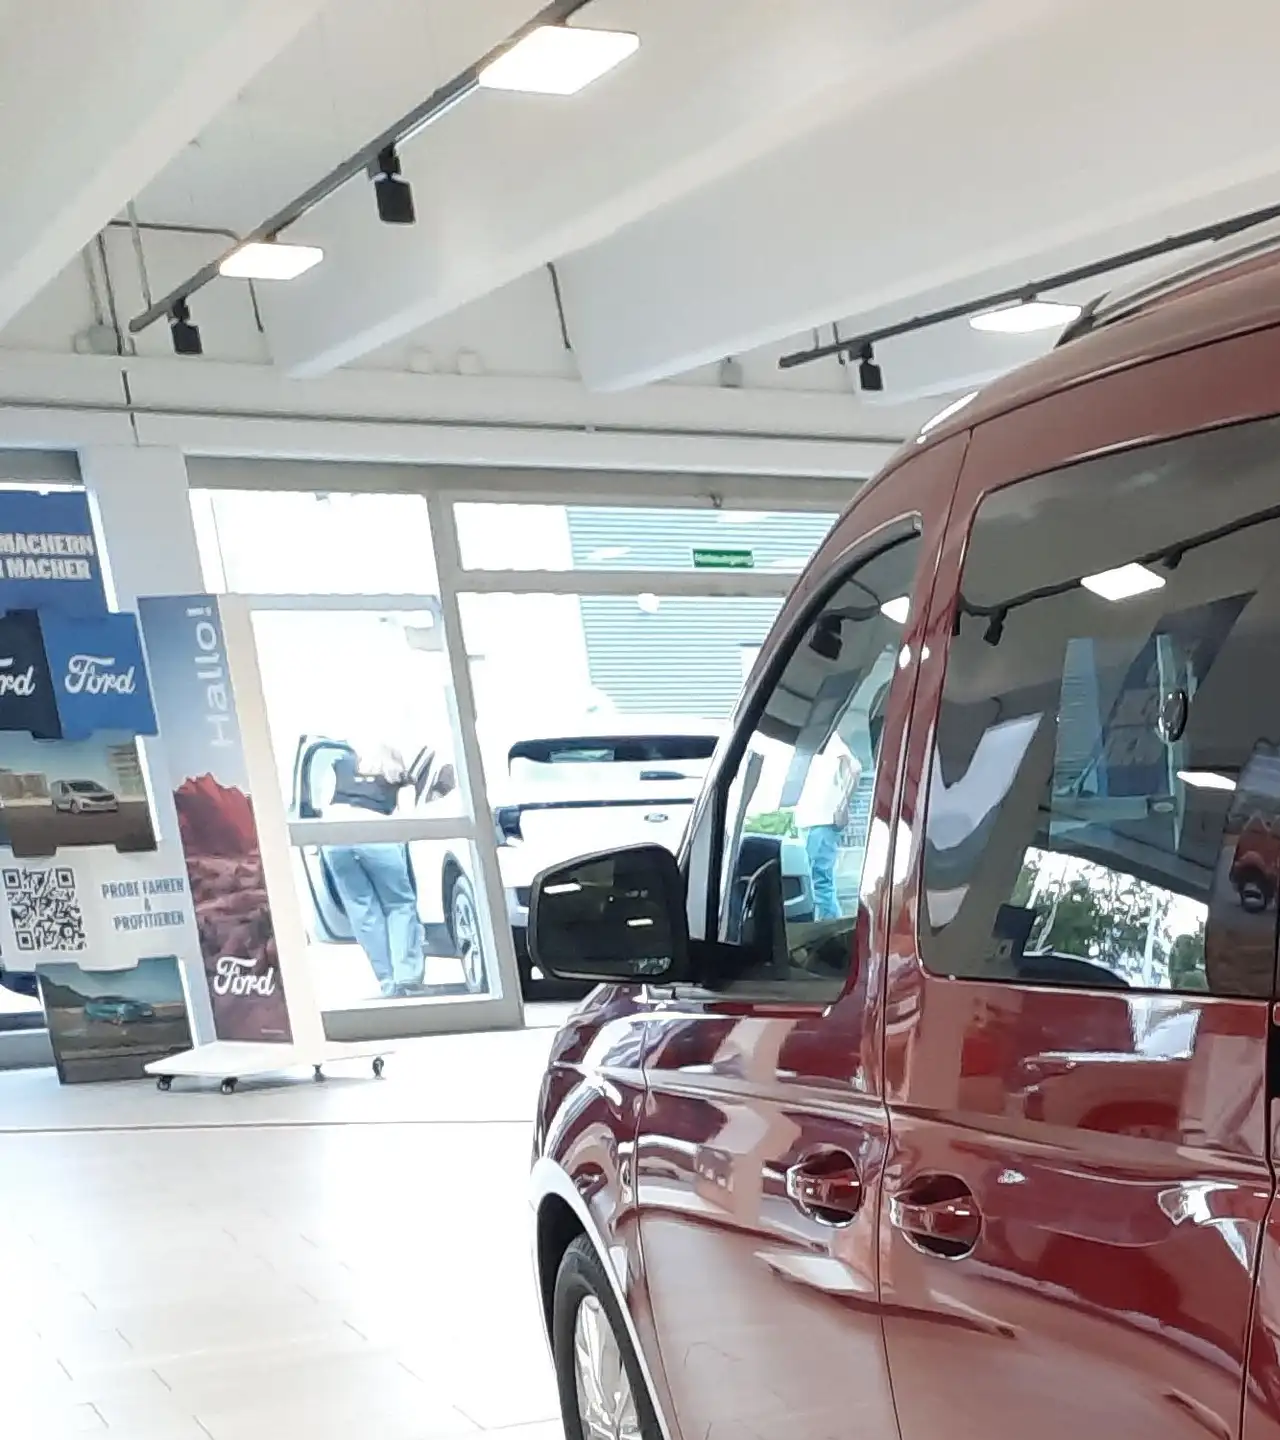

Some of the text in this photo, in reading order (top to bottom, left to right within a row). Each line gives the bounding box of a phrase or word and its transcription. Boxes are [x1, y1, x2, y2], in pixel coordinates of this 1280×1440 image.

[65, 655, 136, 694] Ford
[186, 606, 234, 748] Hallo!
[101, 881, 139, 899] PROBE
[214, 956, 275, 995] Ford
